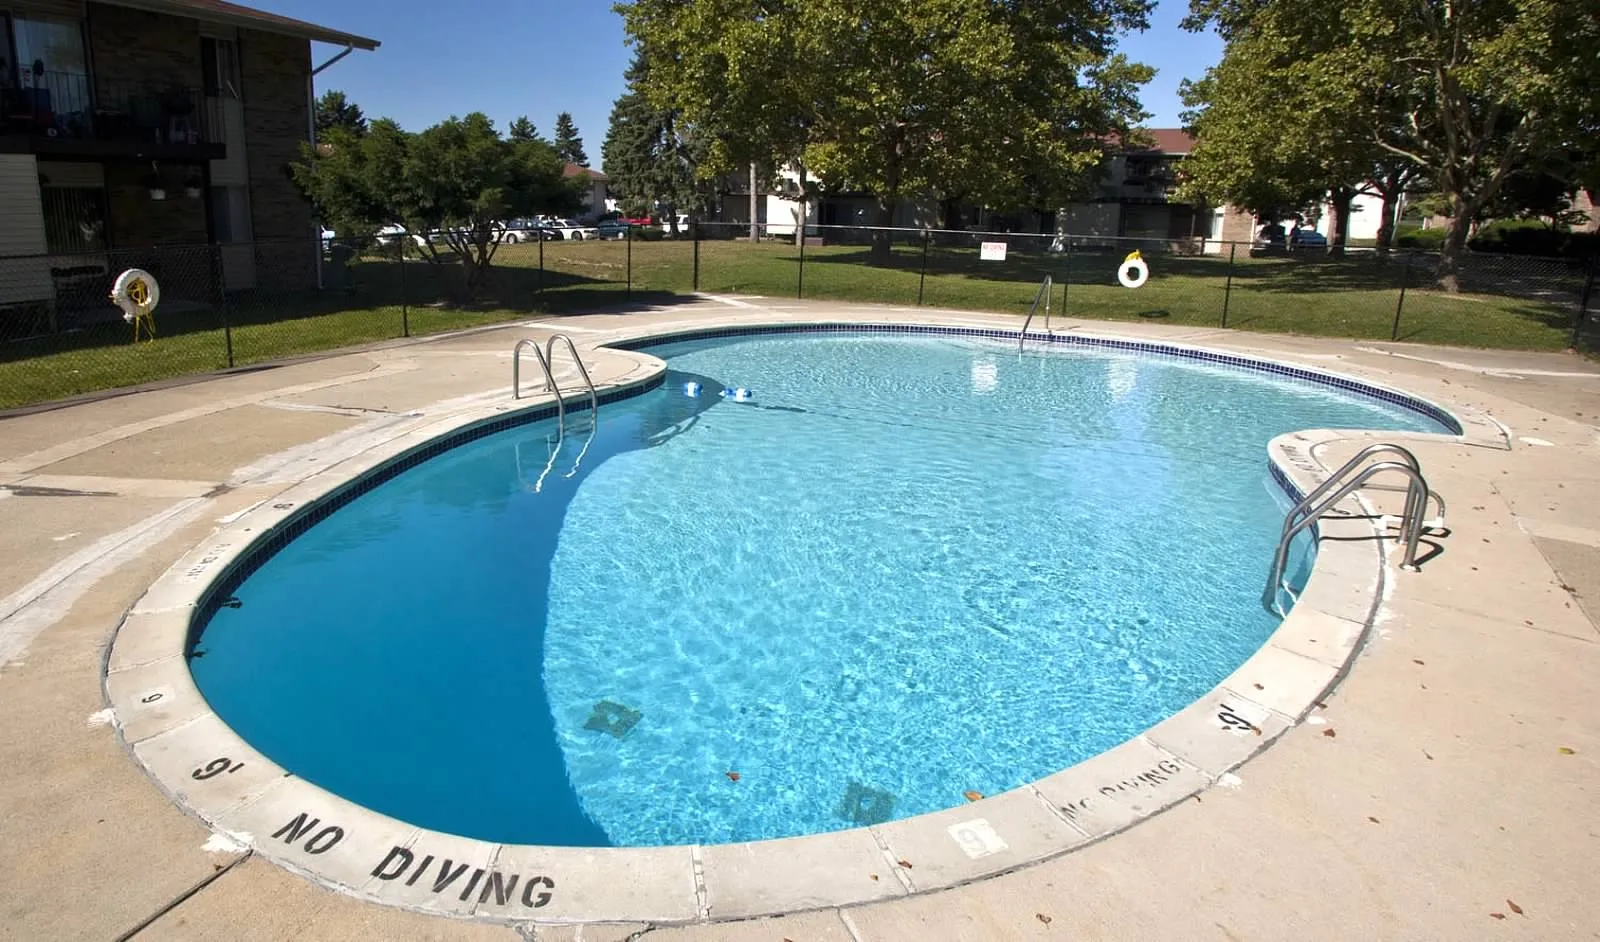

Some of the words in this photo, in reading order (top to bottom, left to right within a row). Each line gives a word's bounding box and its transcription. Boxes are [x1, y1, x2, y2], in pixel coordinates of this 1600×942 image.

[191, 757, 245, 780] 9'
[271, 812, 344, 854] NO
[370, 846, 556, 908] DIVING
